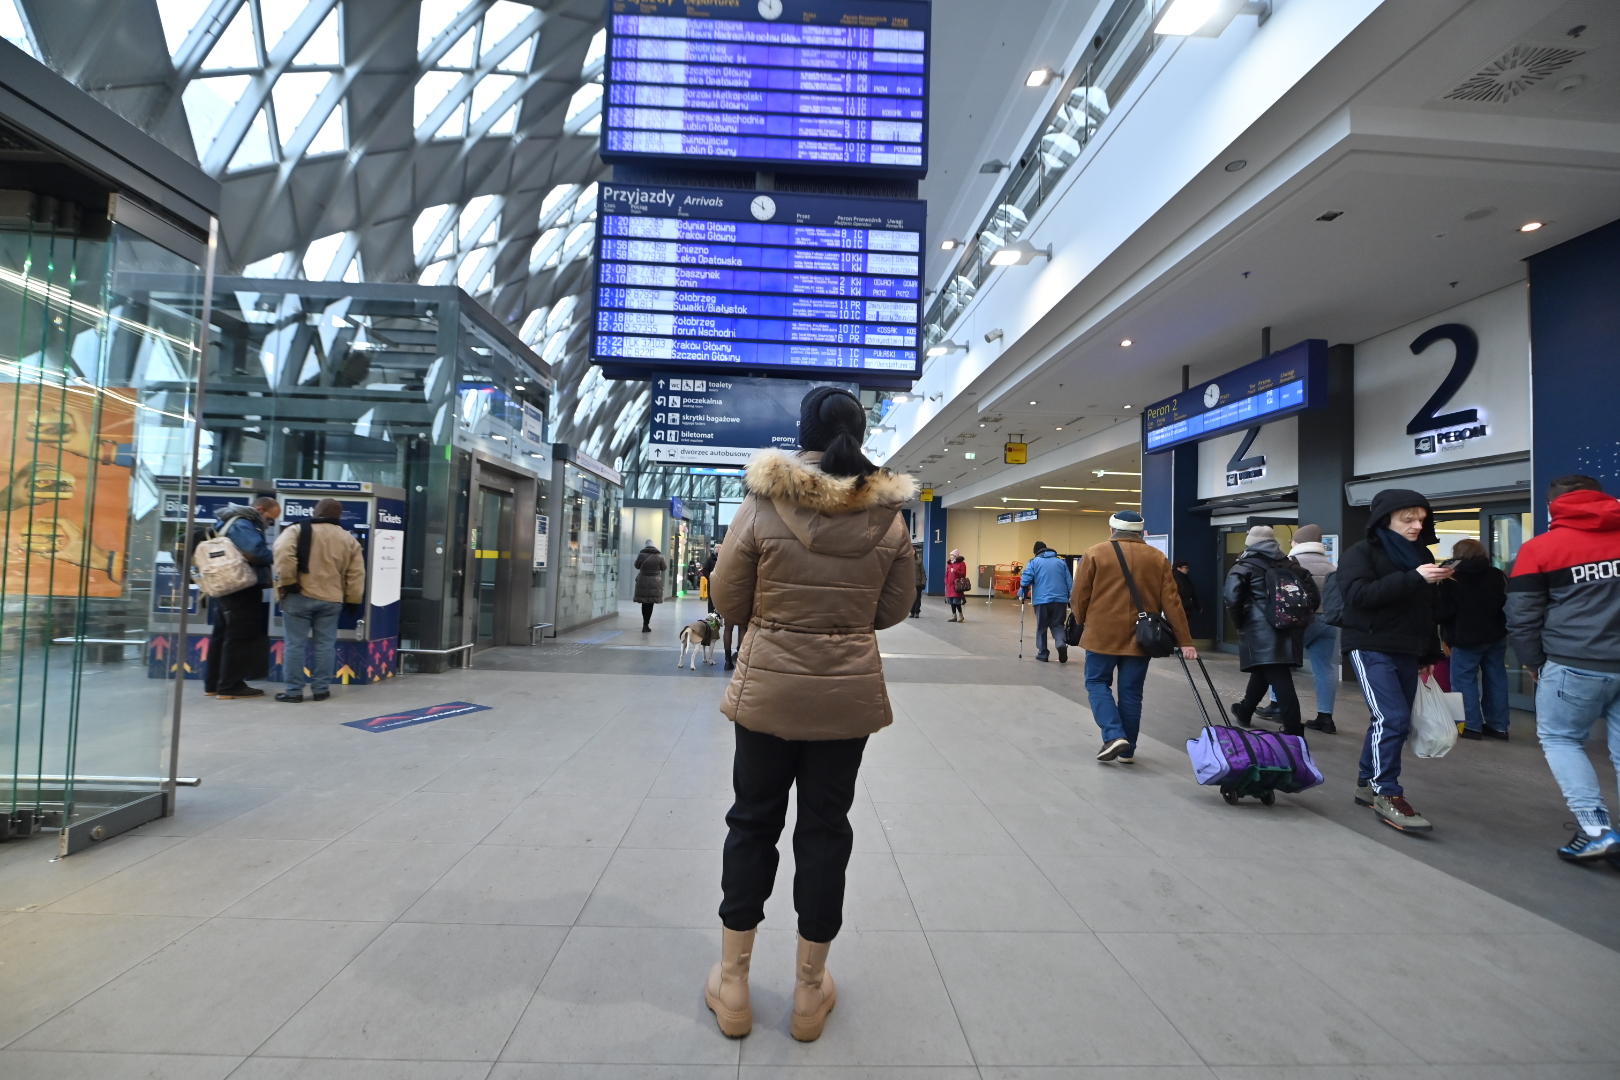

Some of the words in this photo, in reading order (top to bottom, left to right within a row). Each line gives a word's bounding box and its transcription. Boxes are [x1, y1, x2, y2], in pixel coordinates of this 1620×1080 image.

[857, 107, 866, 116] IC
[858, 98, 866, 106] IC
[857, 121, 866, 129] IC
[857, 130, 866, 139] IC
[844, 153, 849, 161] 3
[856, 153, 865, 162] IC
[845, 143, 854, 152] 10
[857, 143, 865, 152] IC
[603, 187, 675, 206] Przyjazdy
[684, 195, 723, 207] Arrivals
[603, 216, 628, 225] 11:20
[677, 220, 704, 231] Gdynia
[707, 221, 735, 232] Główna
[841, 229, 847, 238] 8
[854, 230, 863, 239] IC
[603, 226, 628, 236] 11:33
[676, 231, 705, 240] Kraków
[707, 230, 736, 243] Główny
[841, 239, 851, 248] 10
[853, 239, 863, 248] IC
[602, 239, 627, 249] 11:56
[676, 244, 709, 254] Gniezno
[841, 253, 850, 262] 10
[852, 253, 862, 262] KW
[602, 250, 627, 259] 11:58
[698, 255, 742, 266] Opatowska
[852, 263, 862, 272] KW
[601, 264, 626, 273] 12:09
[840, 277, 845, 285] 2
[851, 277, 862, 286] KW
[600, 274, 625, 283] 12:10
[675, 279, 697, 288] Konin
[840, 286, 845, 295] 5
[851, 287, 861, 296] KW
[896, 290, 909, 298] PKM2
[600, 288, 625, 298] 12:10
[674, 291, 716, 303] Kołobrzeg
[839, 301, 848, 310] 11
[851, 302, 861, 310] PR
[673, 301, 747, 314] Suwałki/Białystok
[839, 310, 849, 319] 10
[851, 311, 860, 320] IC
[598, 322, 623, 332] 12:20
[672, 326, 696, 336] Toruń
[699, 327, 736, 338] Wschodni
[838, 334, 843, 343] 6
[850, 335, 859, 343] PR
[599, 312, 623, 322] 12:18
[673, 316, 715, 327] Kołobrzeg
[839, 324, 848, 333] 10
[851, 325, 860, 334] IC
[596, 346, 622, 356] 12:24
[671, 350, 709, 360] Szczecin
[712, 352, 740, 362] Główny
[837, 358, 842, 366] 3
[850, 358, 859, 367] IC
[597, 336, 622, 346] 12:22
[672, 341, 700, 350] Kraków
[703, 342, 731, 352] Główny
[850, 349, 859, 357] IC
[873, 350, 895, 358] PUŁASKI
[709, 381, 732, 389] toalety
[1406, 322, 1479, 435] 2
[683, 397, 723, 405] poczekalnia
[1148, 404, 1170, 420] Peron
[1172, 399, 1178, 411] 2
[706, 415, 740, 423] bagażowe
[681, 431, 714, 439] biletomat
[1436, 424, 1487, 444] PERON
[681, 448, 708, 456] dworzec
[710, 450, 751, 458] autobusowy
[286, 504, 315, 517] Bilet
[378, 512, 402, 524] Tickets
